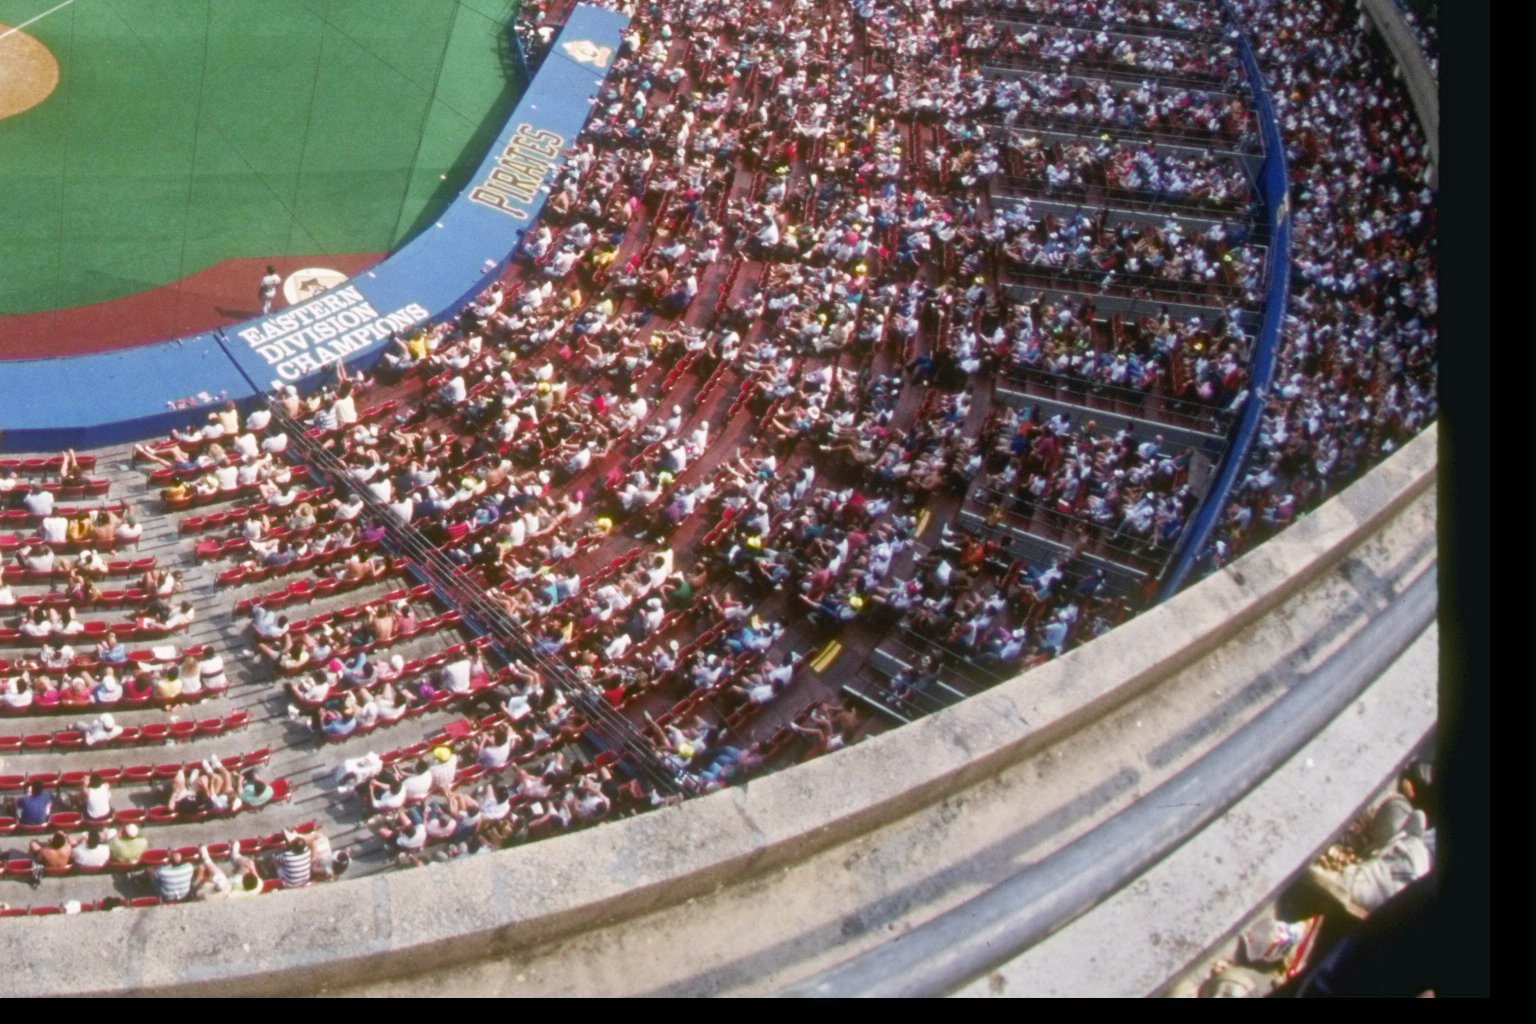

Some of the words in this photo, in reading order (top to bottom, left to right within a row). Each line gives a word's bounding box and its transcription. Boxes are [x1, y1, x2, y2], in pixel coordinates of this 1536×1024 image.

[468, 123, 565, 220] PIRATES
[238, 285, 364, 348] EASTERN
[256, 301, 379, 365] DIVISION
[275, 303, 430, 380] CHAMPIONS
